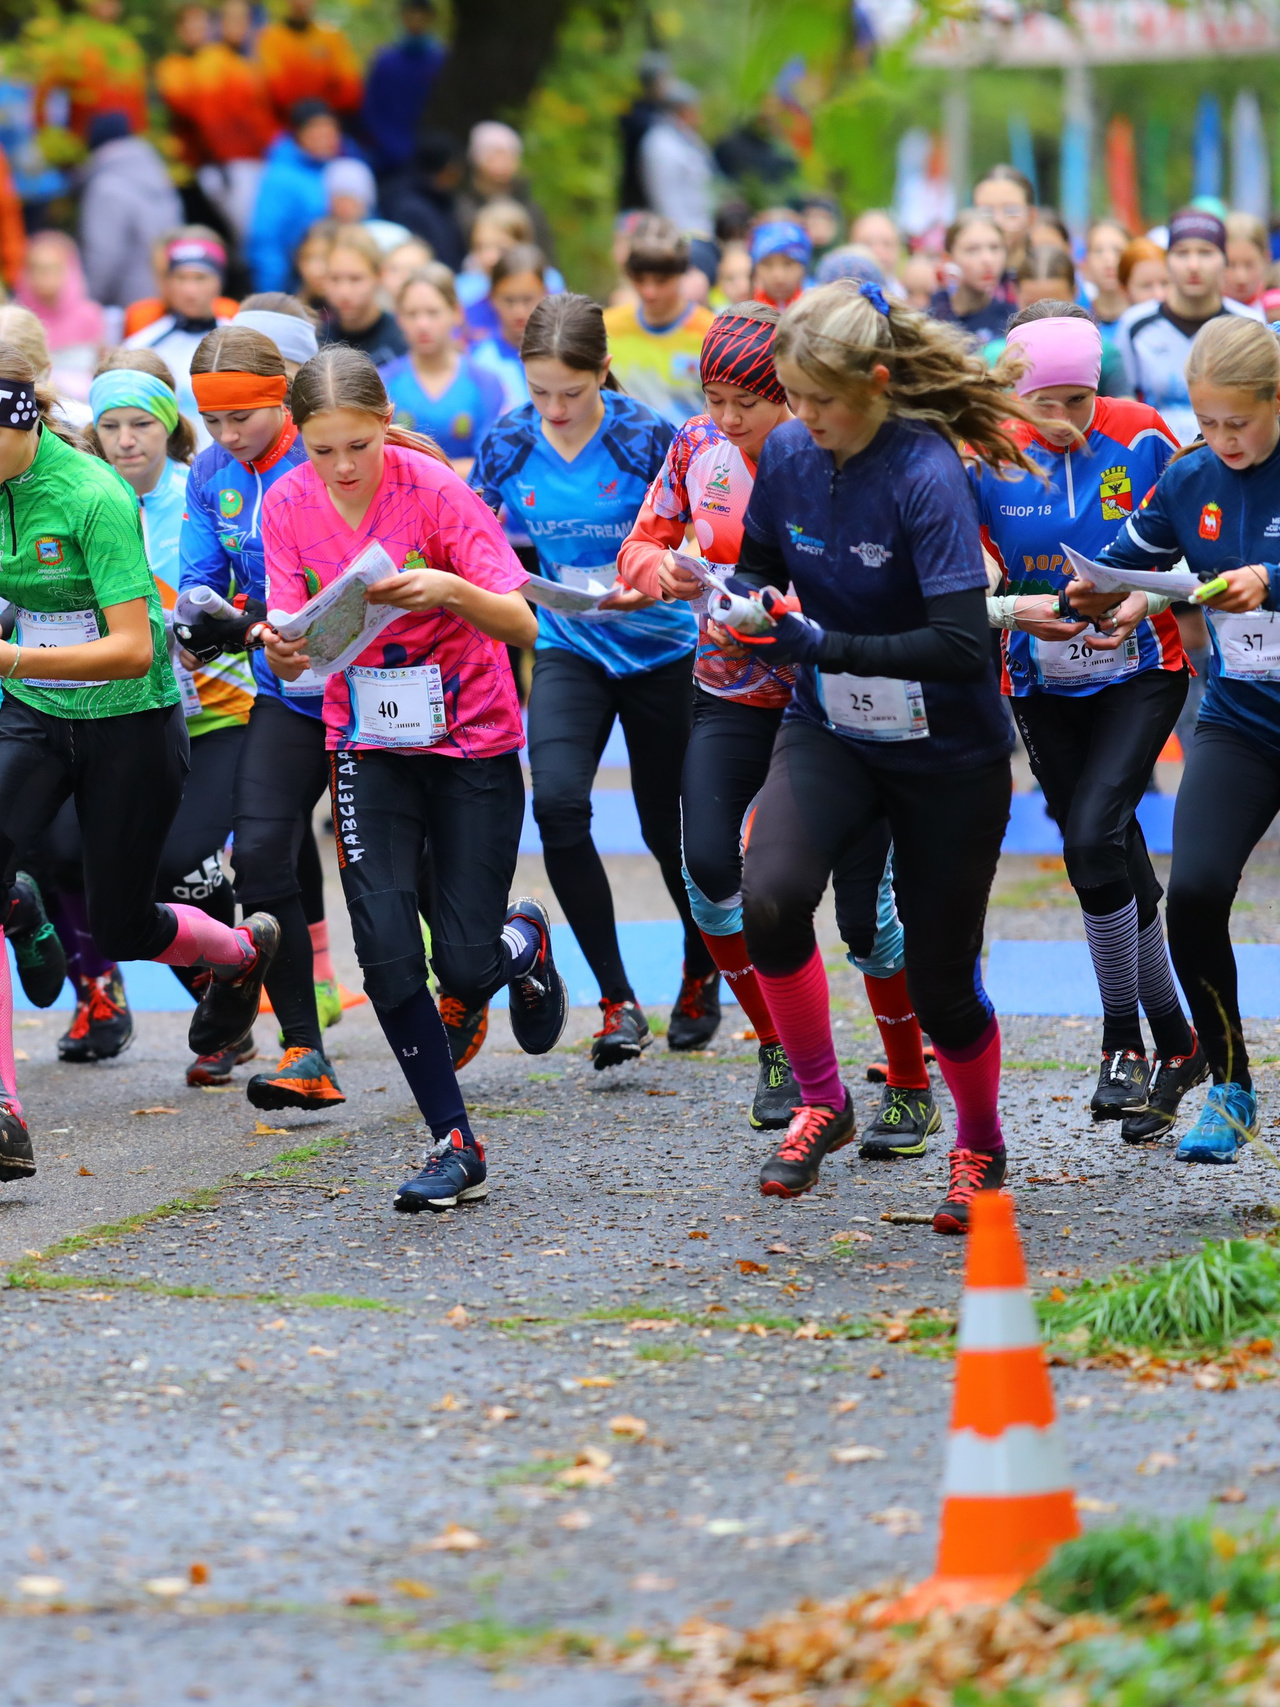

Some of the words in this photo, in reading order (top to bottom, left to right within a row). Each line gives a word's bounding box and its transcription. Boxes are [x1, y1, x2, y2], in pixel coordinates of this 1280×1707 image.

[999, 504, 1034, 517] СШОР
[1037, 504, 1052, 516] 18
[1242, 634, 1263, 651] 37
[1067, 643, 1093, 661] 26
[377, 700, 399, 719] 40
[849, 693, 874, 711] 25
[337, 751, 366, 863] НАВСЕГДА
